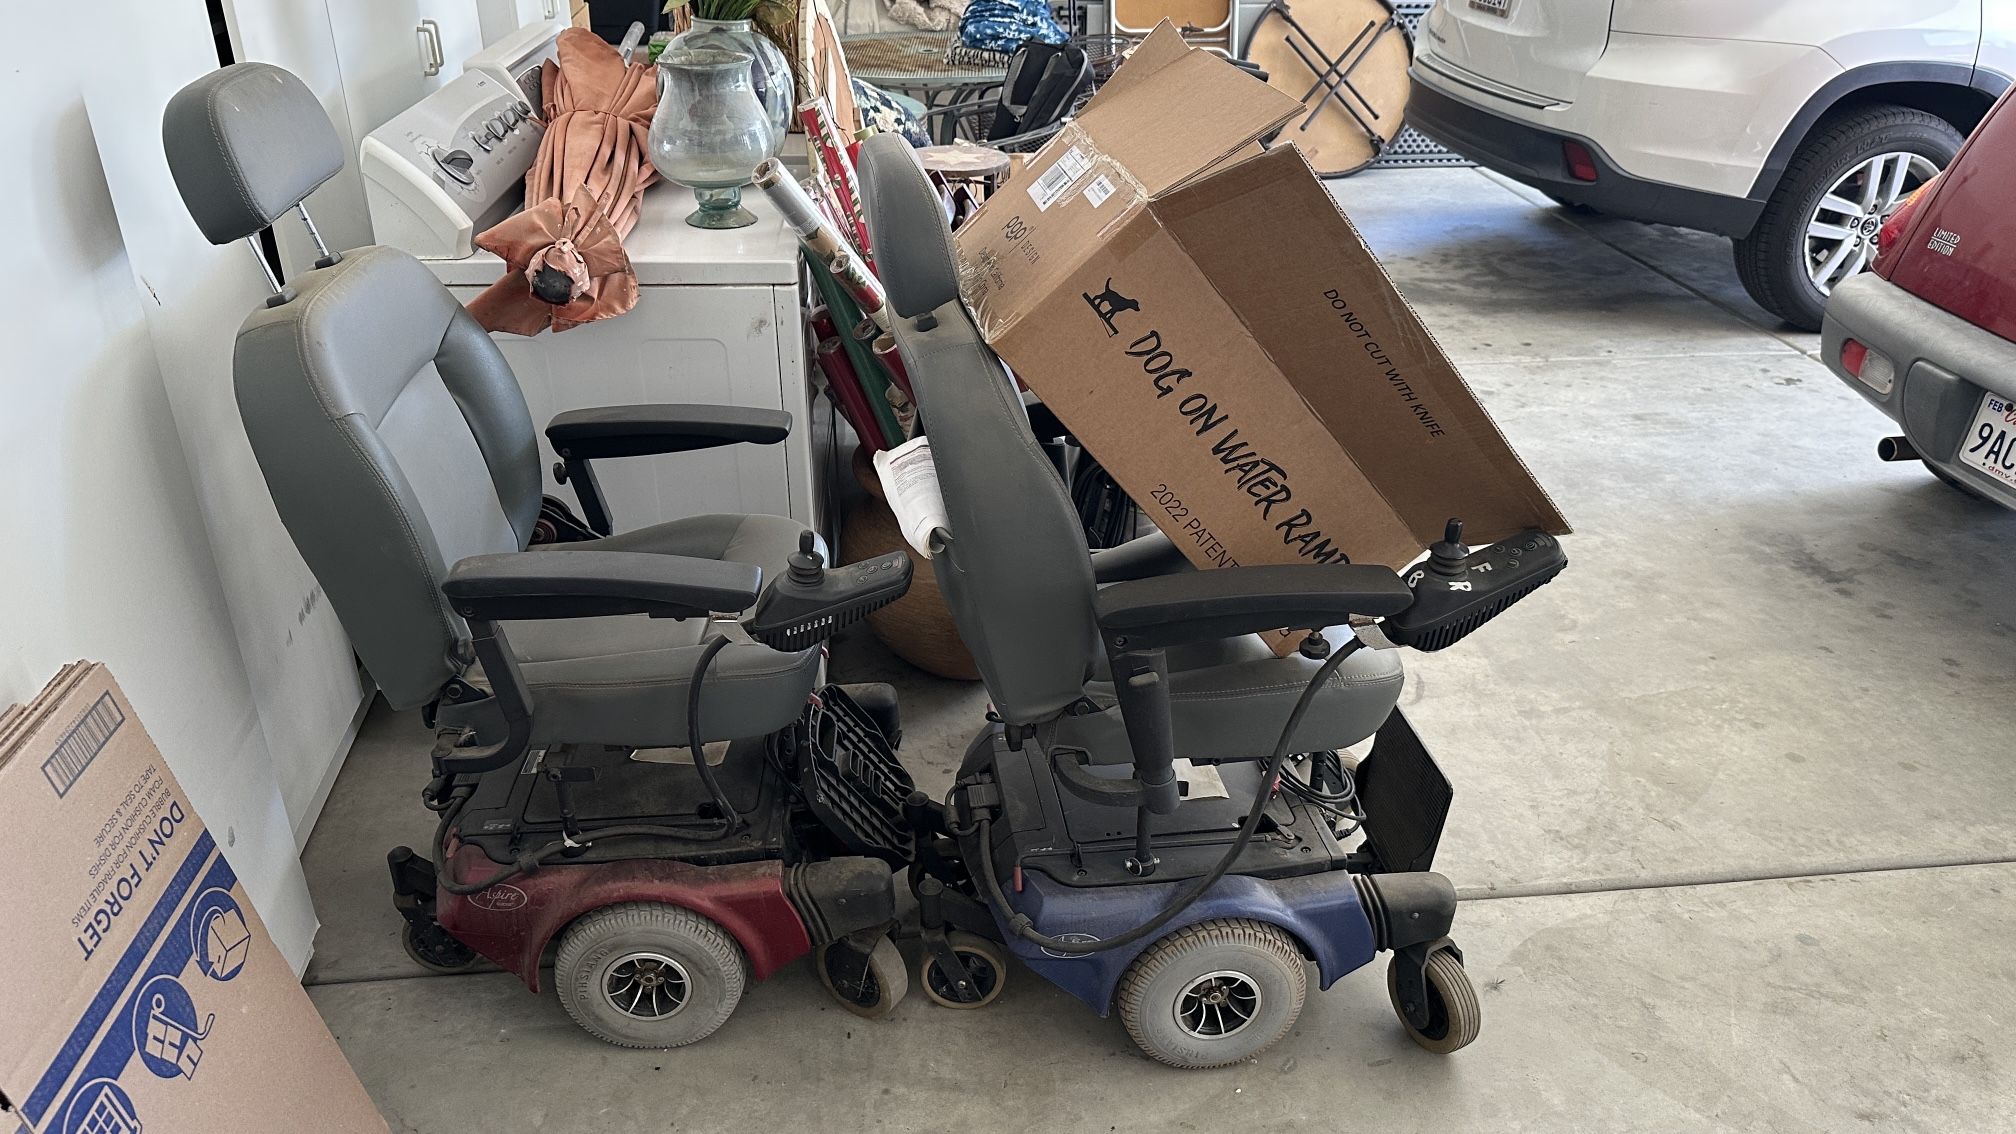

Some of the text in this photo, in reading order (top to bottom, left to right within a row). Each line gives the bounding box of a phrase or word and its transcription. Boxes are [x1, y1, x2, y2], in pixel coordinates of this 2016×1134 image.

[1927, 239, 1954, 257] EDITION
[1933, 227, 1960, 244] LIMITED
[1021, 241, 1040, 265] DESIGN
[1323, 288, 1446, 438] DO NOT CUT WITH KNIFE
[1987, 398, 2004, 413] FEB
[1124, 329, 1193, 400] DOG
[1178, 393, 1229, 437] ON
[1211, 428, 1292, 521] WATER
[1150, 483, 1241, 568] 2022 PATENT
[133, 782, 144, 793] TO
[139, 764, 157, 785] TAPE
[120, 790, 136, 810] SEAL
[88, 775, 164, 879] FOAM CUSHION FOR DISHES
[93, 814, 118, 847] SECURE
[71, 787, 171, 927] BUBBLE CUSHION FOR FRAGILE ITEMS
[76, 800, 185, 962] DON'T FORGET
[579, 947, 609, 1001] PIHSIANG
